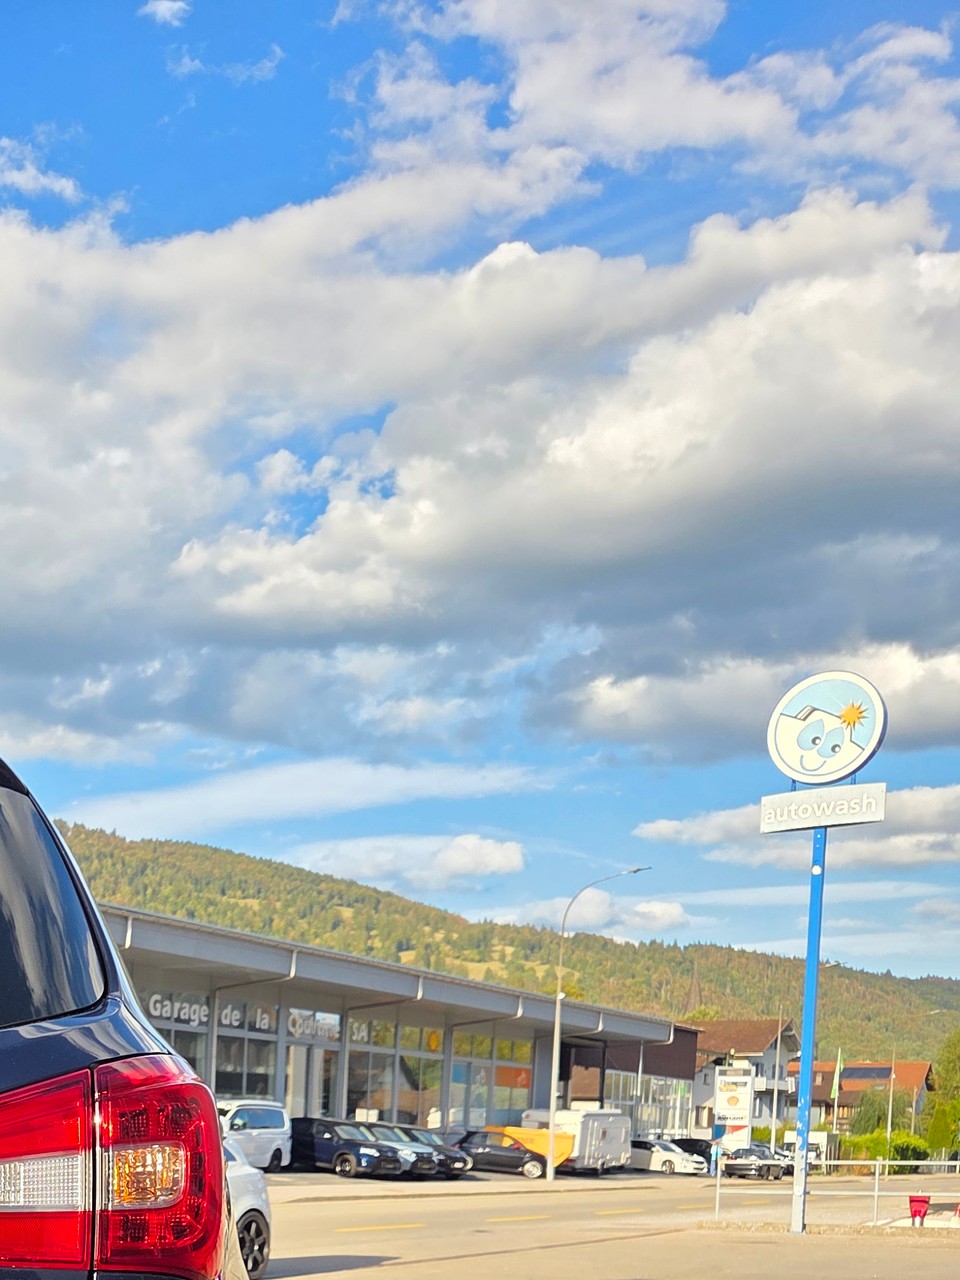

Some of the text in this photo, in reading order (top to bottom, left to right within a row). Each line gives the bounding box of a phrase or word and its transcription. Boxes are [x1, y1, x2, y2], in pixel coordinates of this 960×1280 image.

[764, 793, 877, 824] autowash
[149, 994, 209, 1027] Garage
[221, 1004, 240, 1026] de
[255, 1008, 269, 1030] la
[352, 1023, 368, 1042] SA
